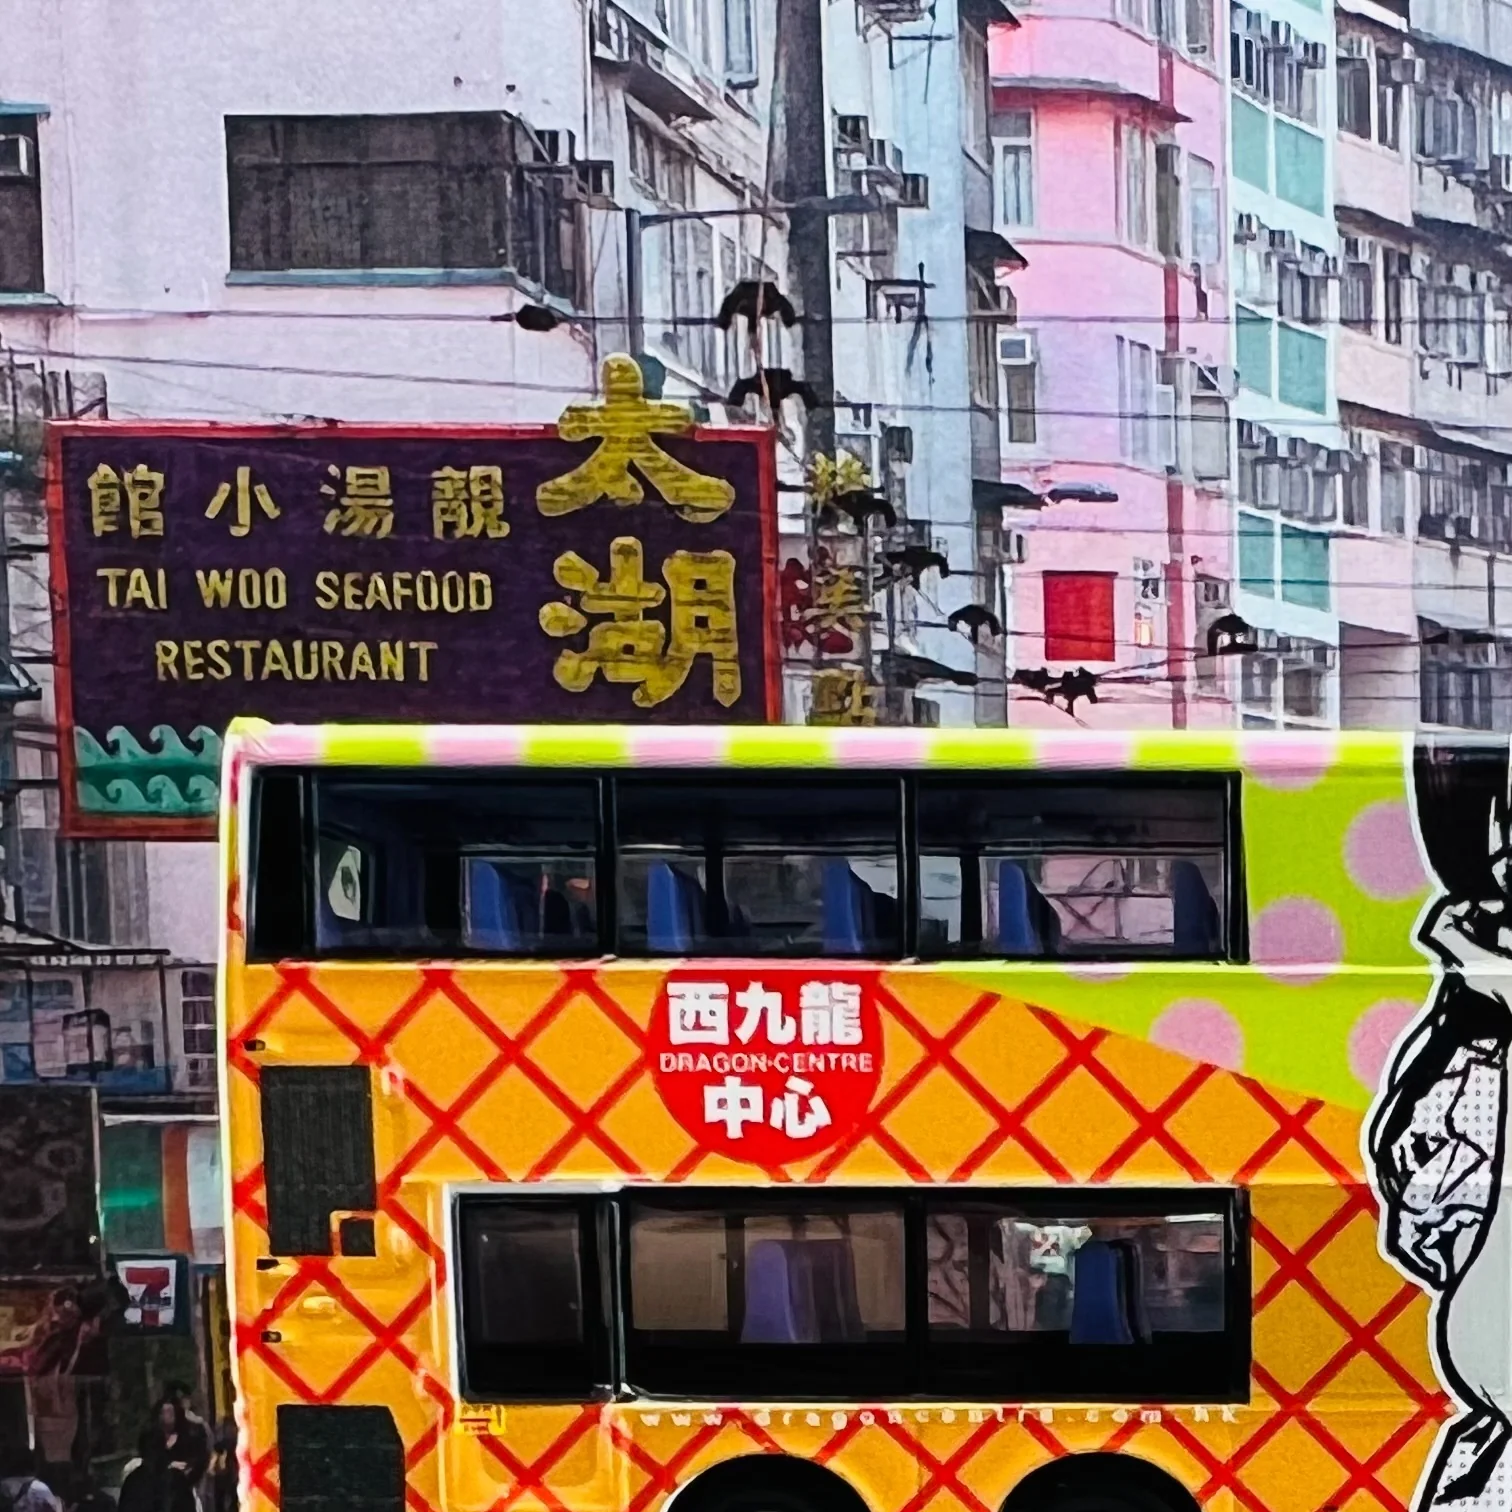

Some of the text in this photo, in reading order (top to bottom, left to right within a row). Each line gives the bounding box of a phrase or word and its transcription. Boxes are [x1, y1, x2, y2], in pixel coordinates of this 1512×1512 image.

[537, 353, 742, 708] 太湖
[97, 567, 494, 613] TAI WOO SEAFOOD
[155, 639, 438, 682] RESTAURANT
[666, 980, 863, 1046] 西九龍
[703, 1075, 833, 1139] 中心
